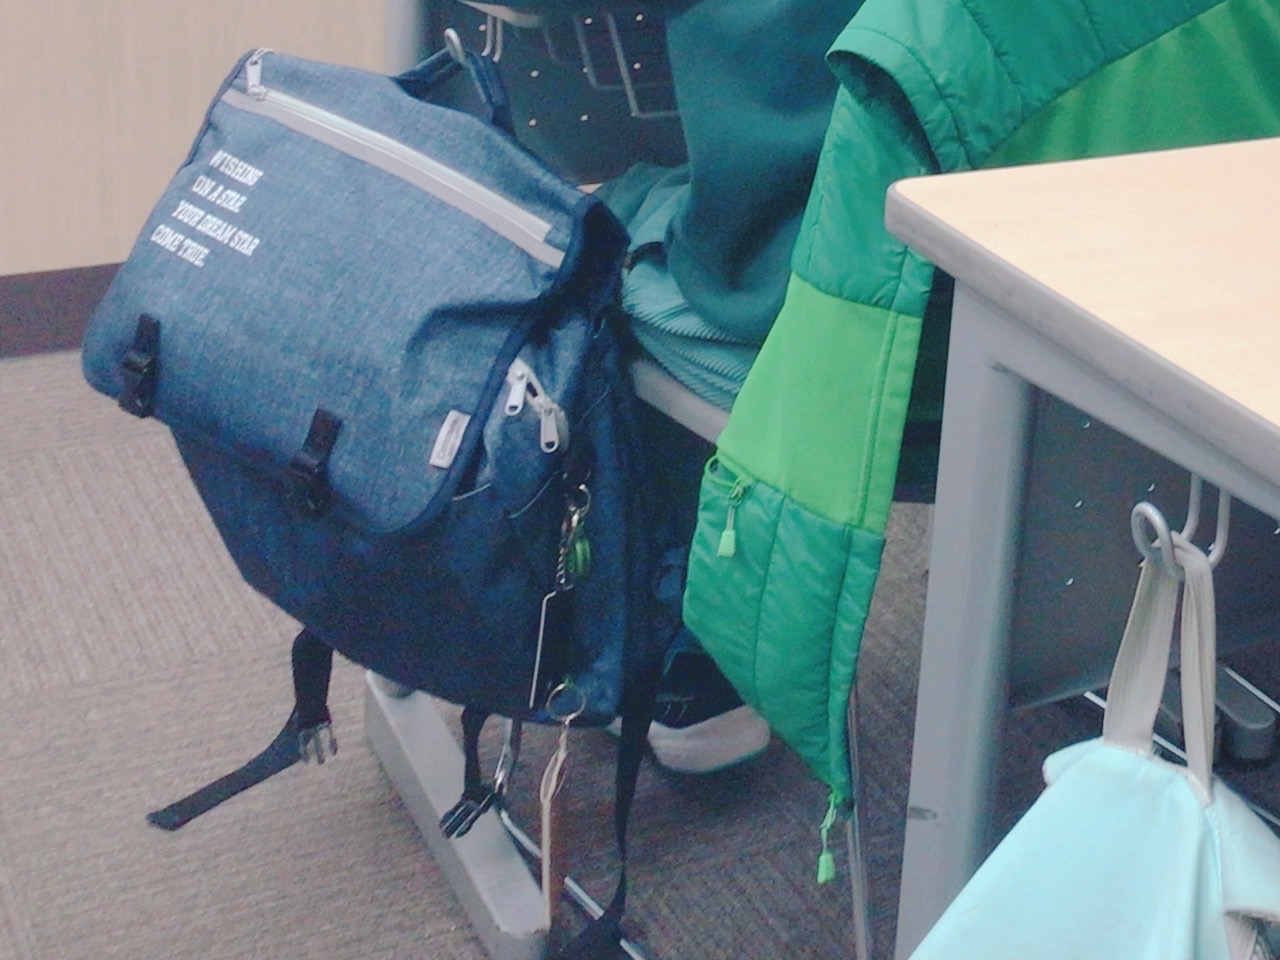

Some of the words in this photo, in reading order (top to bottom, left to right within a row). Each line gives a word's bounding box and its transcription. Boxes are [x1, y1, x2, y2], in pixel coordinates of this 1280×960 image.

[209, 150, 264, 186] WISHING
[191, 175, 217, 197] ON
[207, 185, 224, 202] A
[150, 224, 185, 252] COME
[171, 200, 206, 227] YOUR
[197, 214, 237, 244] DREAM
[229, 230, 260, 256] STAR
